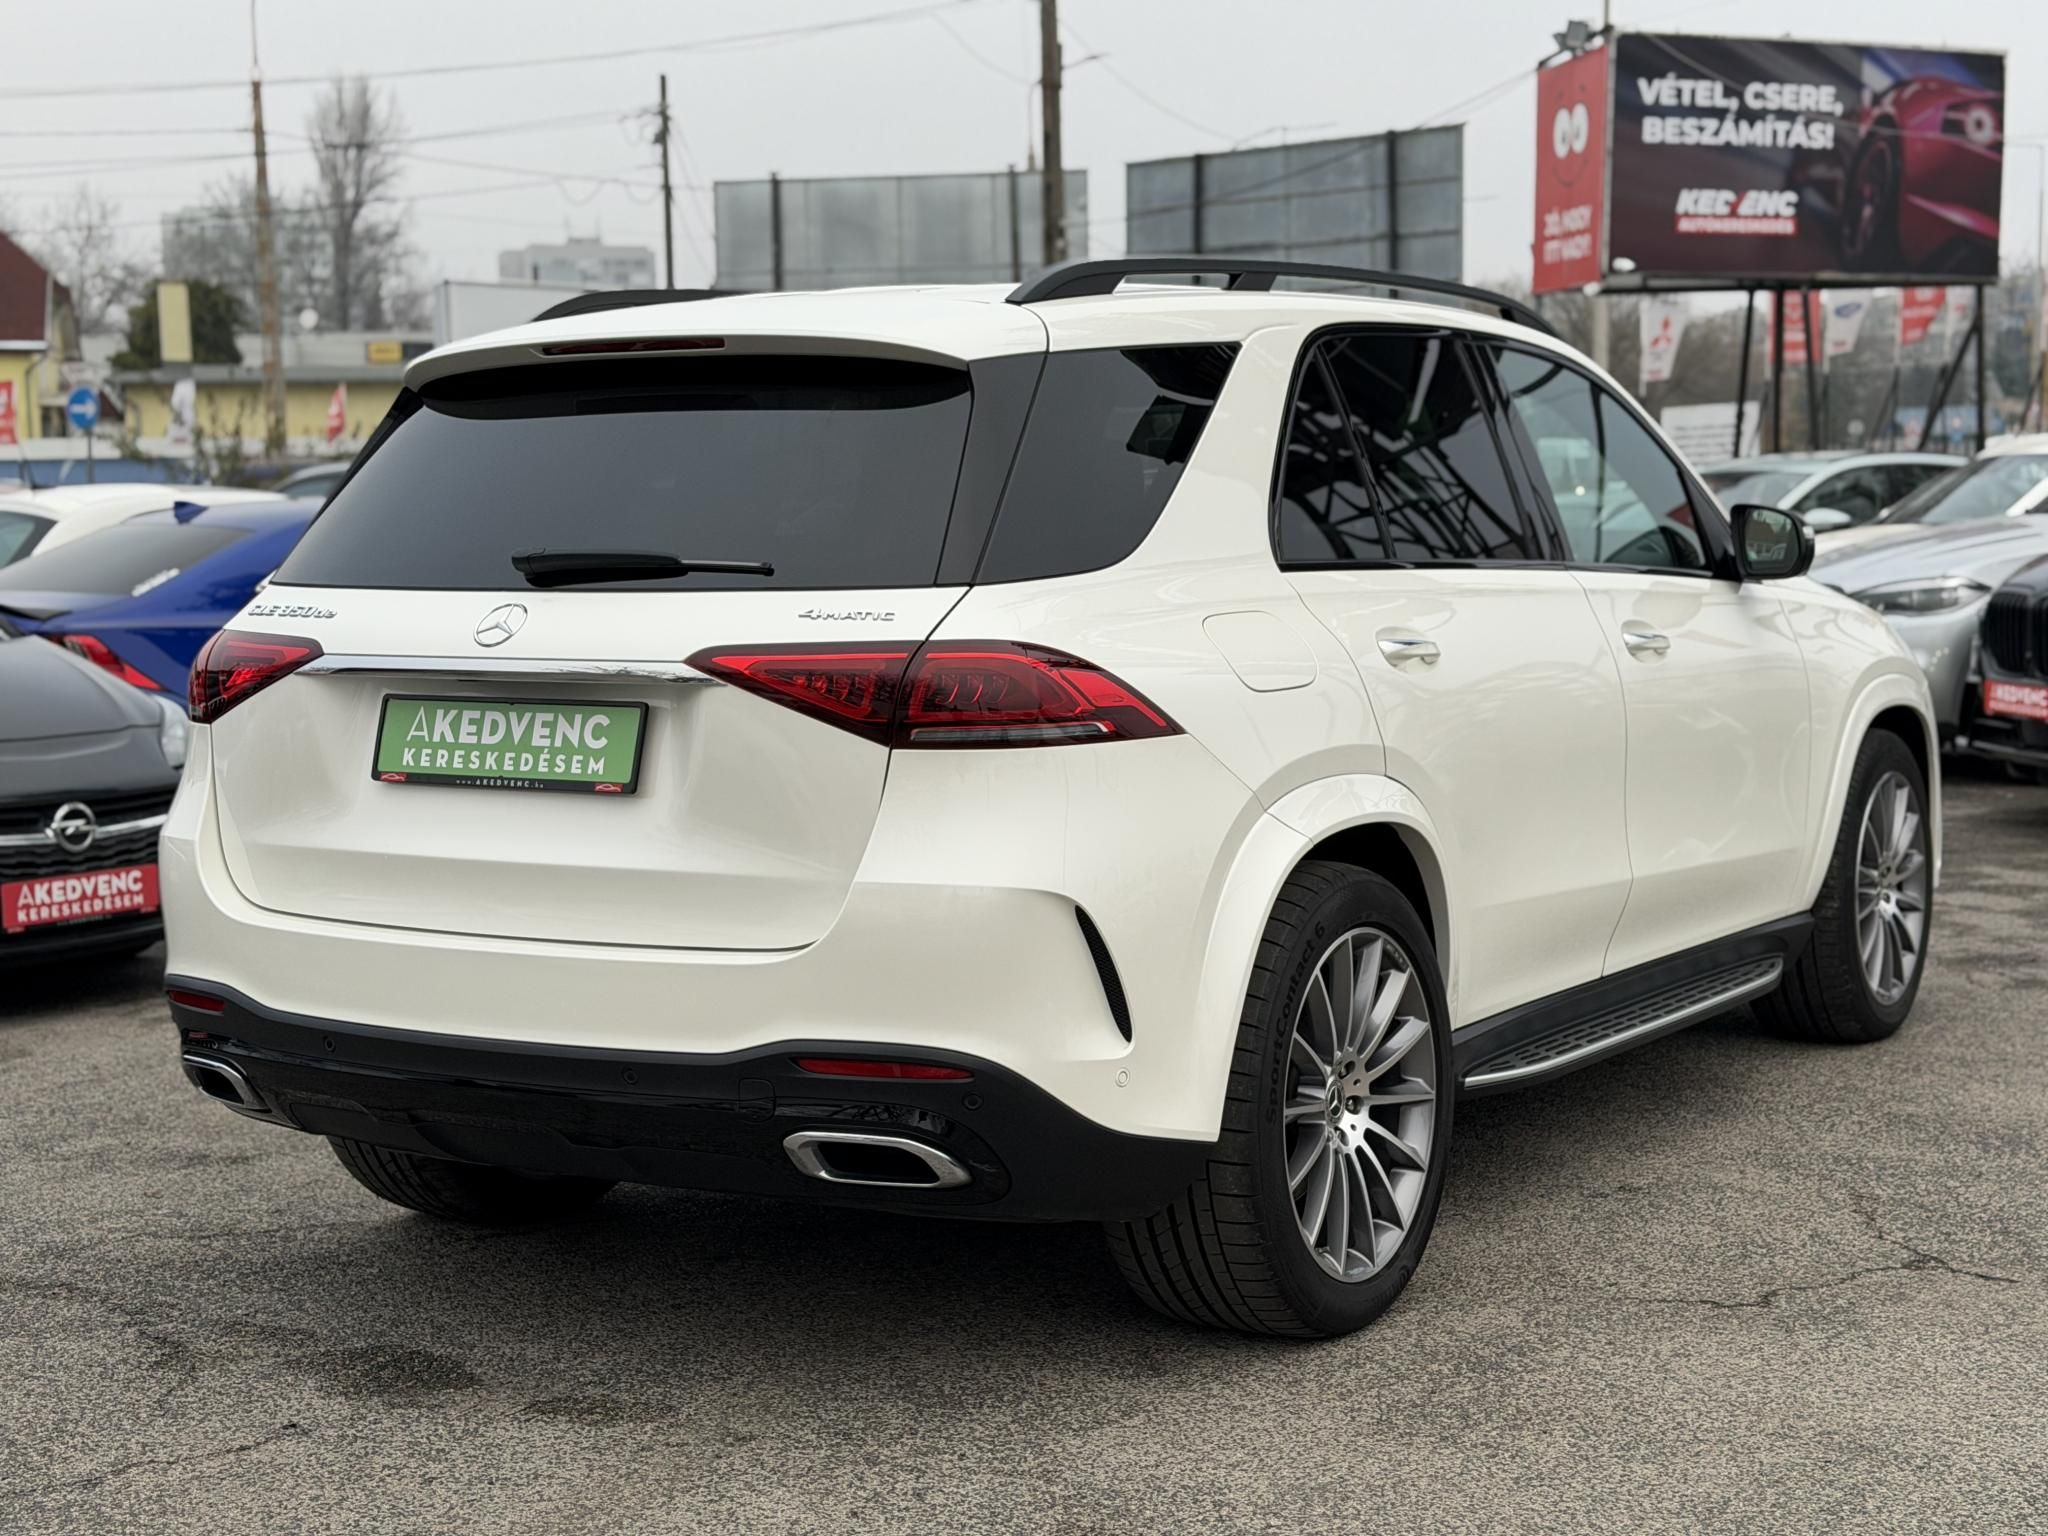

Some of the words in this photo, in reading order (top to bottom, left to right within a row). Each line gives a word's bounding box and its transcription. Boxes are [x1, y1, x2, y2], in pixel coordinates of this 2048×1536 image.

[1637, 71, 1740, 112] VÉTEL,
[1743, 81, 1844, 117] CSERE,
[1641, 112, 1835, 150] BESZÁMÍTÁS!
[798, 608, 895, 622] 4MATIC
[406, 705, 611, 750] AKEDVENC
[402, 747, 605, 775] KERESKEDÉSEM
[17, 869, 143, 907] AKEDVENC
[1266, 940, 1315, 1126] SportContact
[1314, 920, 1326, 938] 6
